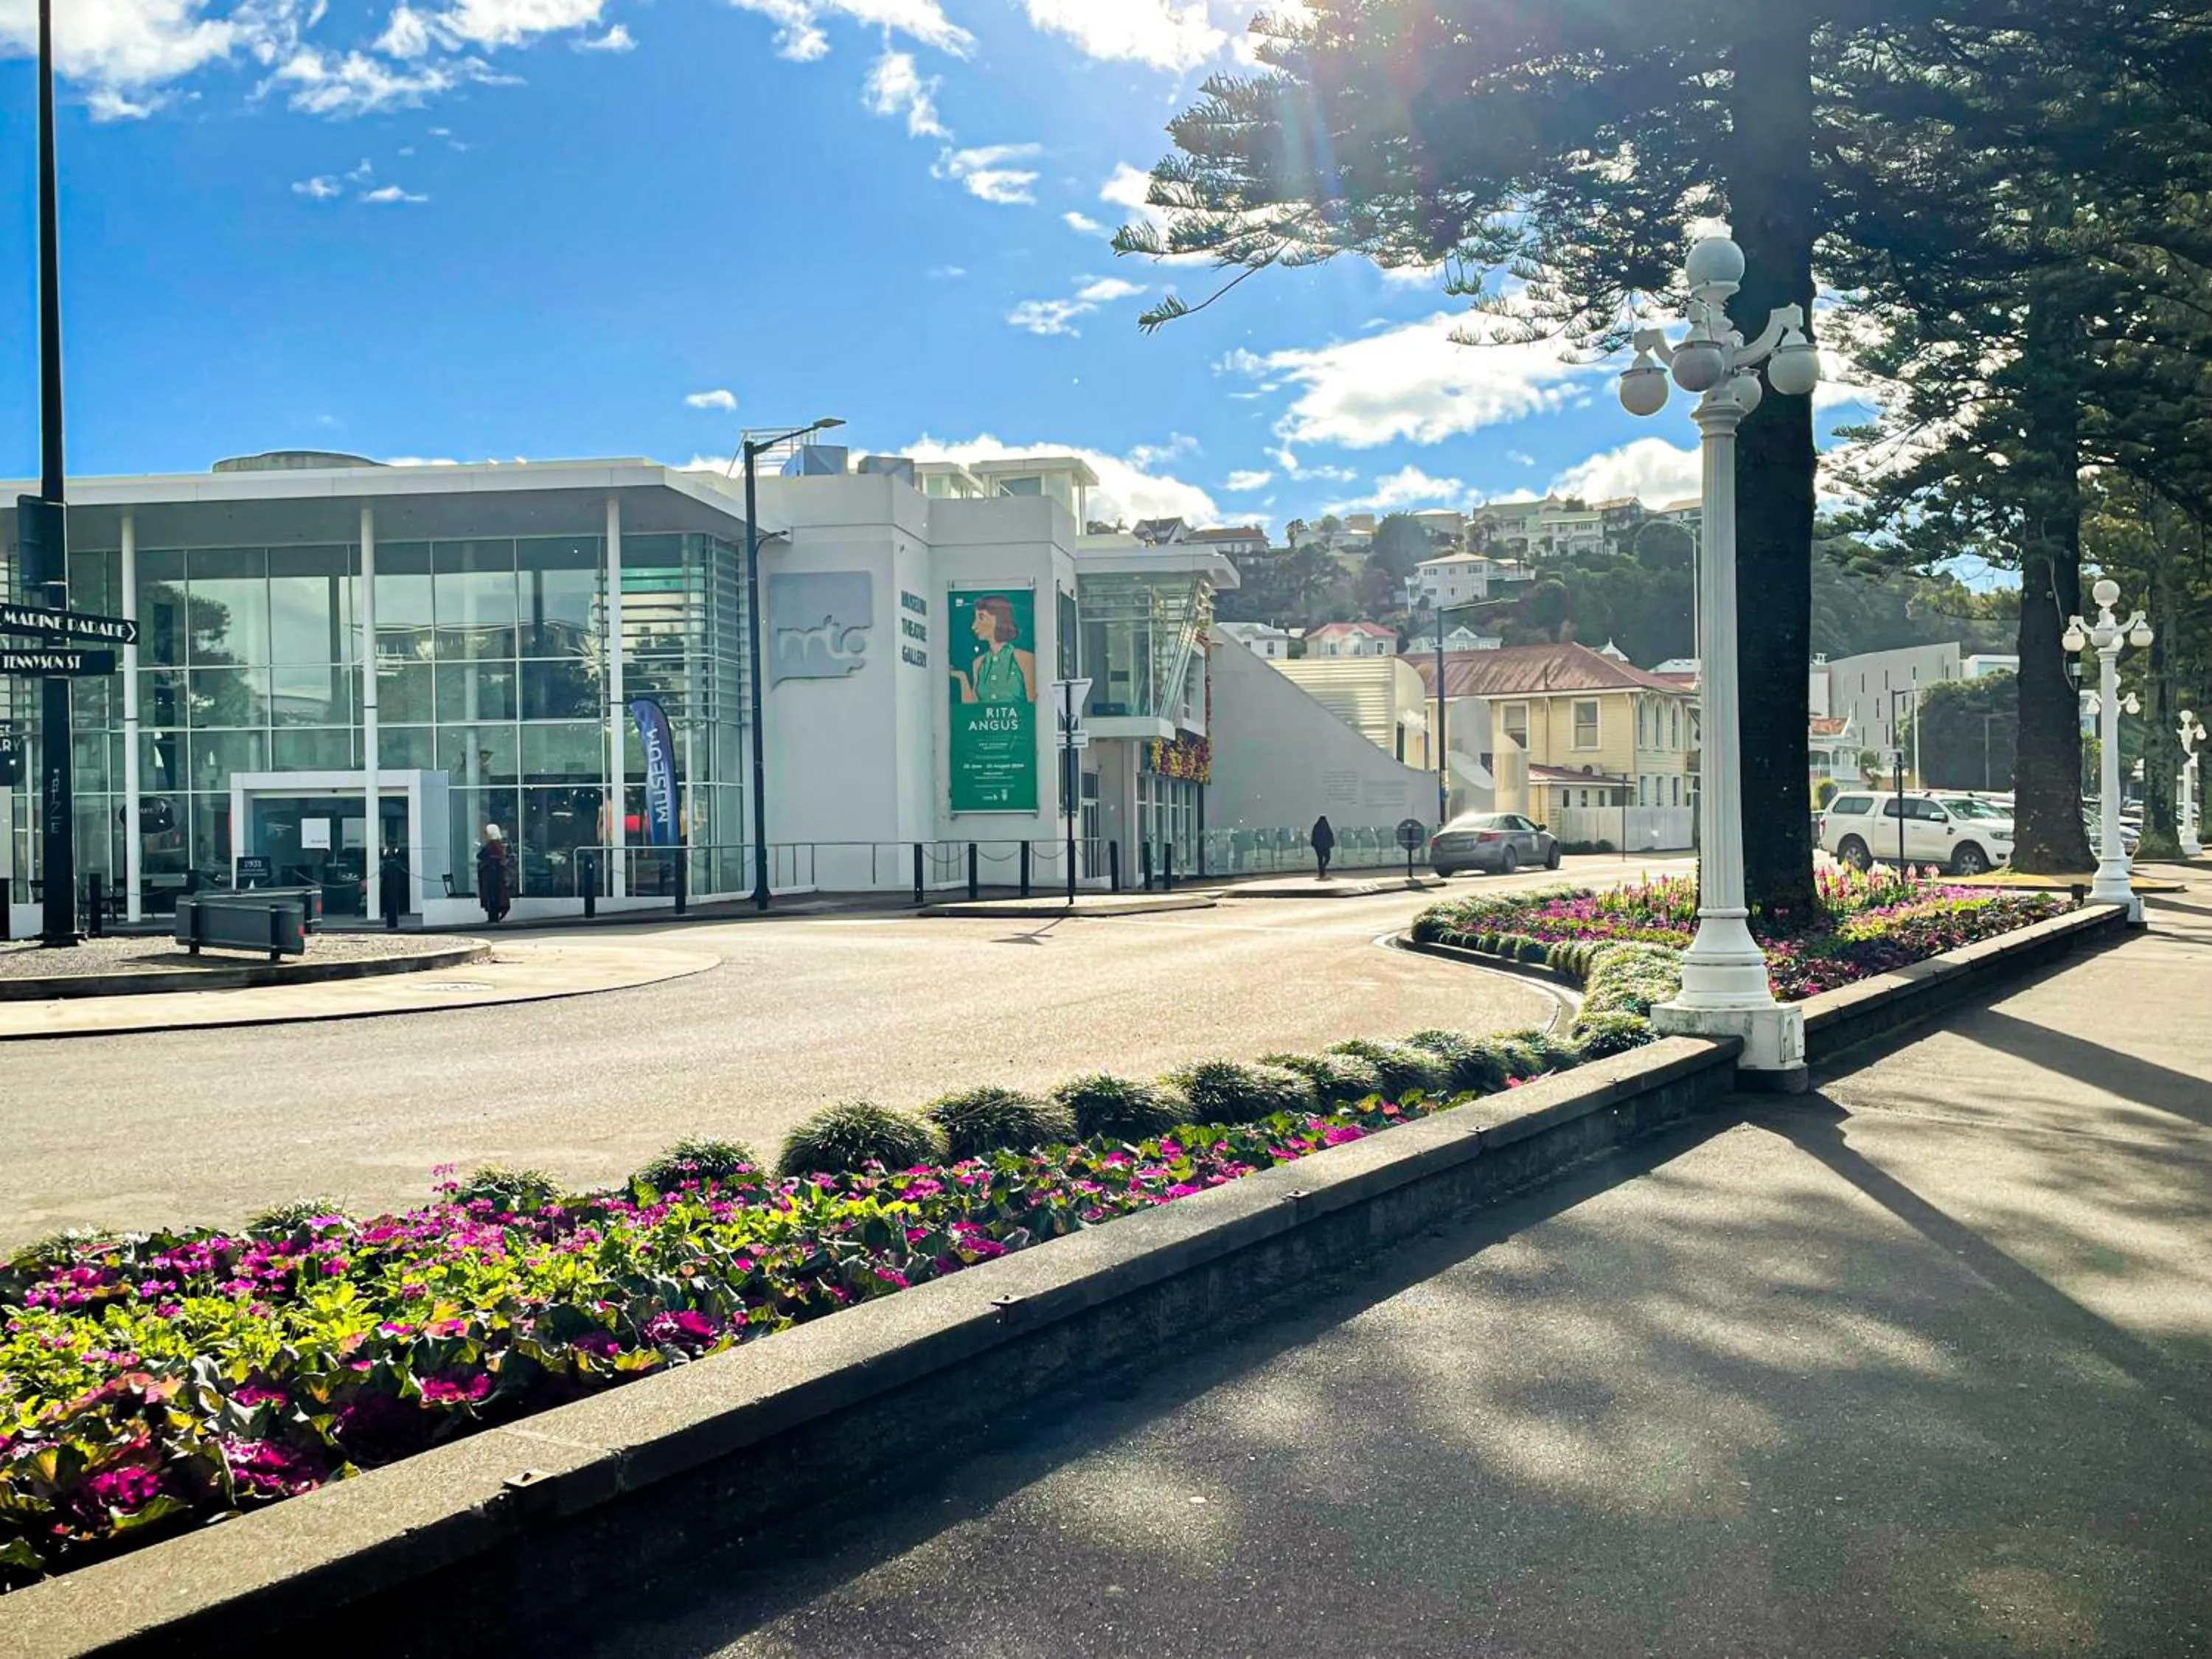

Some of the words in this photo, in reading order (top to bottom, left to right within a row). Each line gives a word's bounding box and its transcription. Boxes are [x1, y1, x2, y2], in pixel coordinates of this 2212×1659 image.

[4, 610, 63, 630] MARINE
[67, 618, 126, 638] PARADE
[3, 654, 64, 669] TENNYSON
[67, 654, 82, 669] ST
[986, 707, 1018, 718] RITA
[968, 720, 1019, 731] ANGUS
[647, 728, 668, 824] MUSEUM
